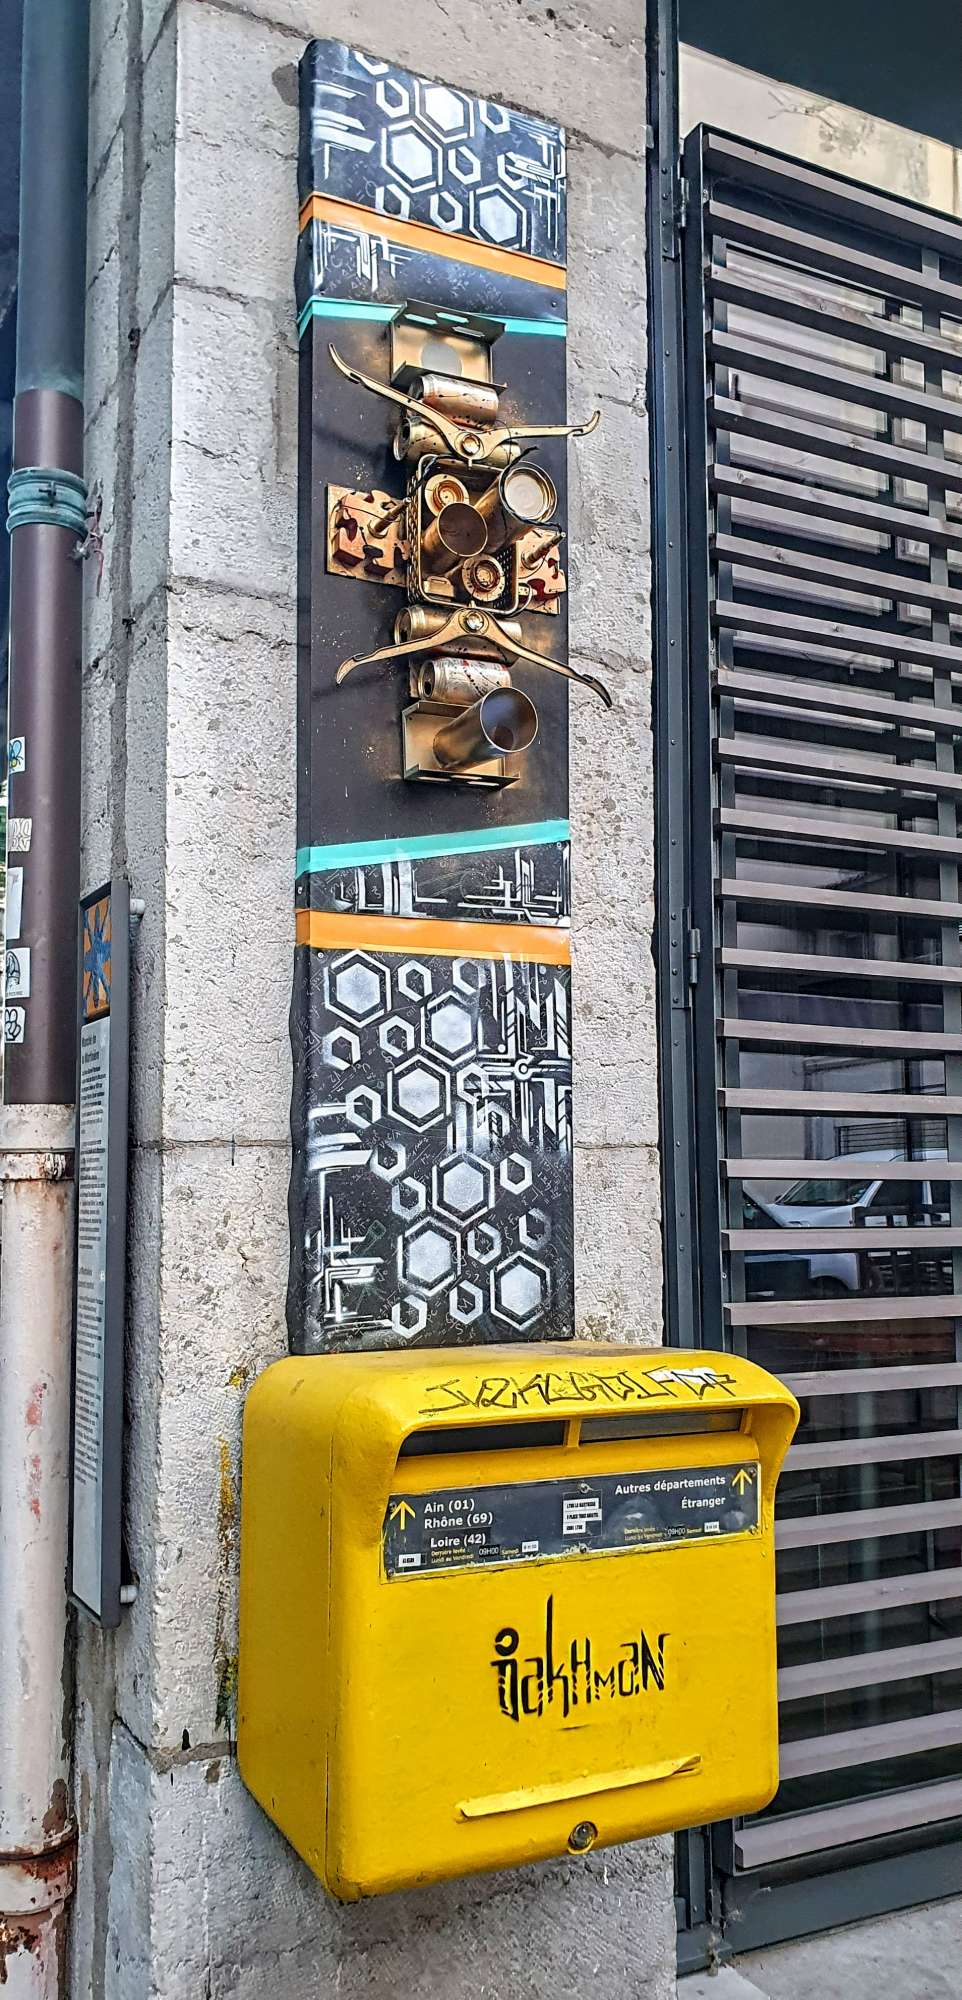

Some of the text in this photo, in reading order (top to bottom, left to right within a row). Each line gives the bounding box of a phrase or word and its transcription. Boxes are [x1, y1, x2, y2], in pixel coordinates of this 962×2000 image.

[615, 1476, 726, 1495] Autres départements
[424, 1499, 475, 1513] Ain (01)
[681, 1496, 726, 1509] Étranger
[424, 1512, 493, 1529] Rhône (69)
[430, 1533, 486, 1548] Loire (42)
